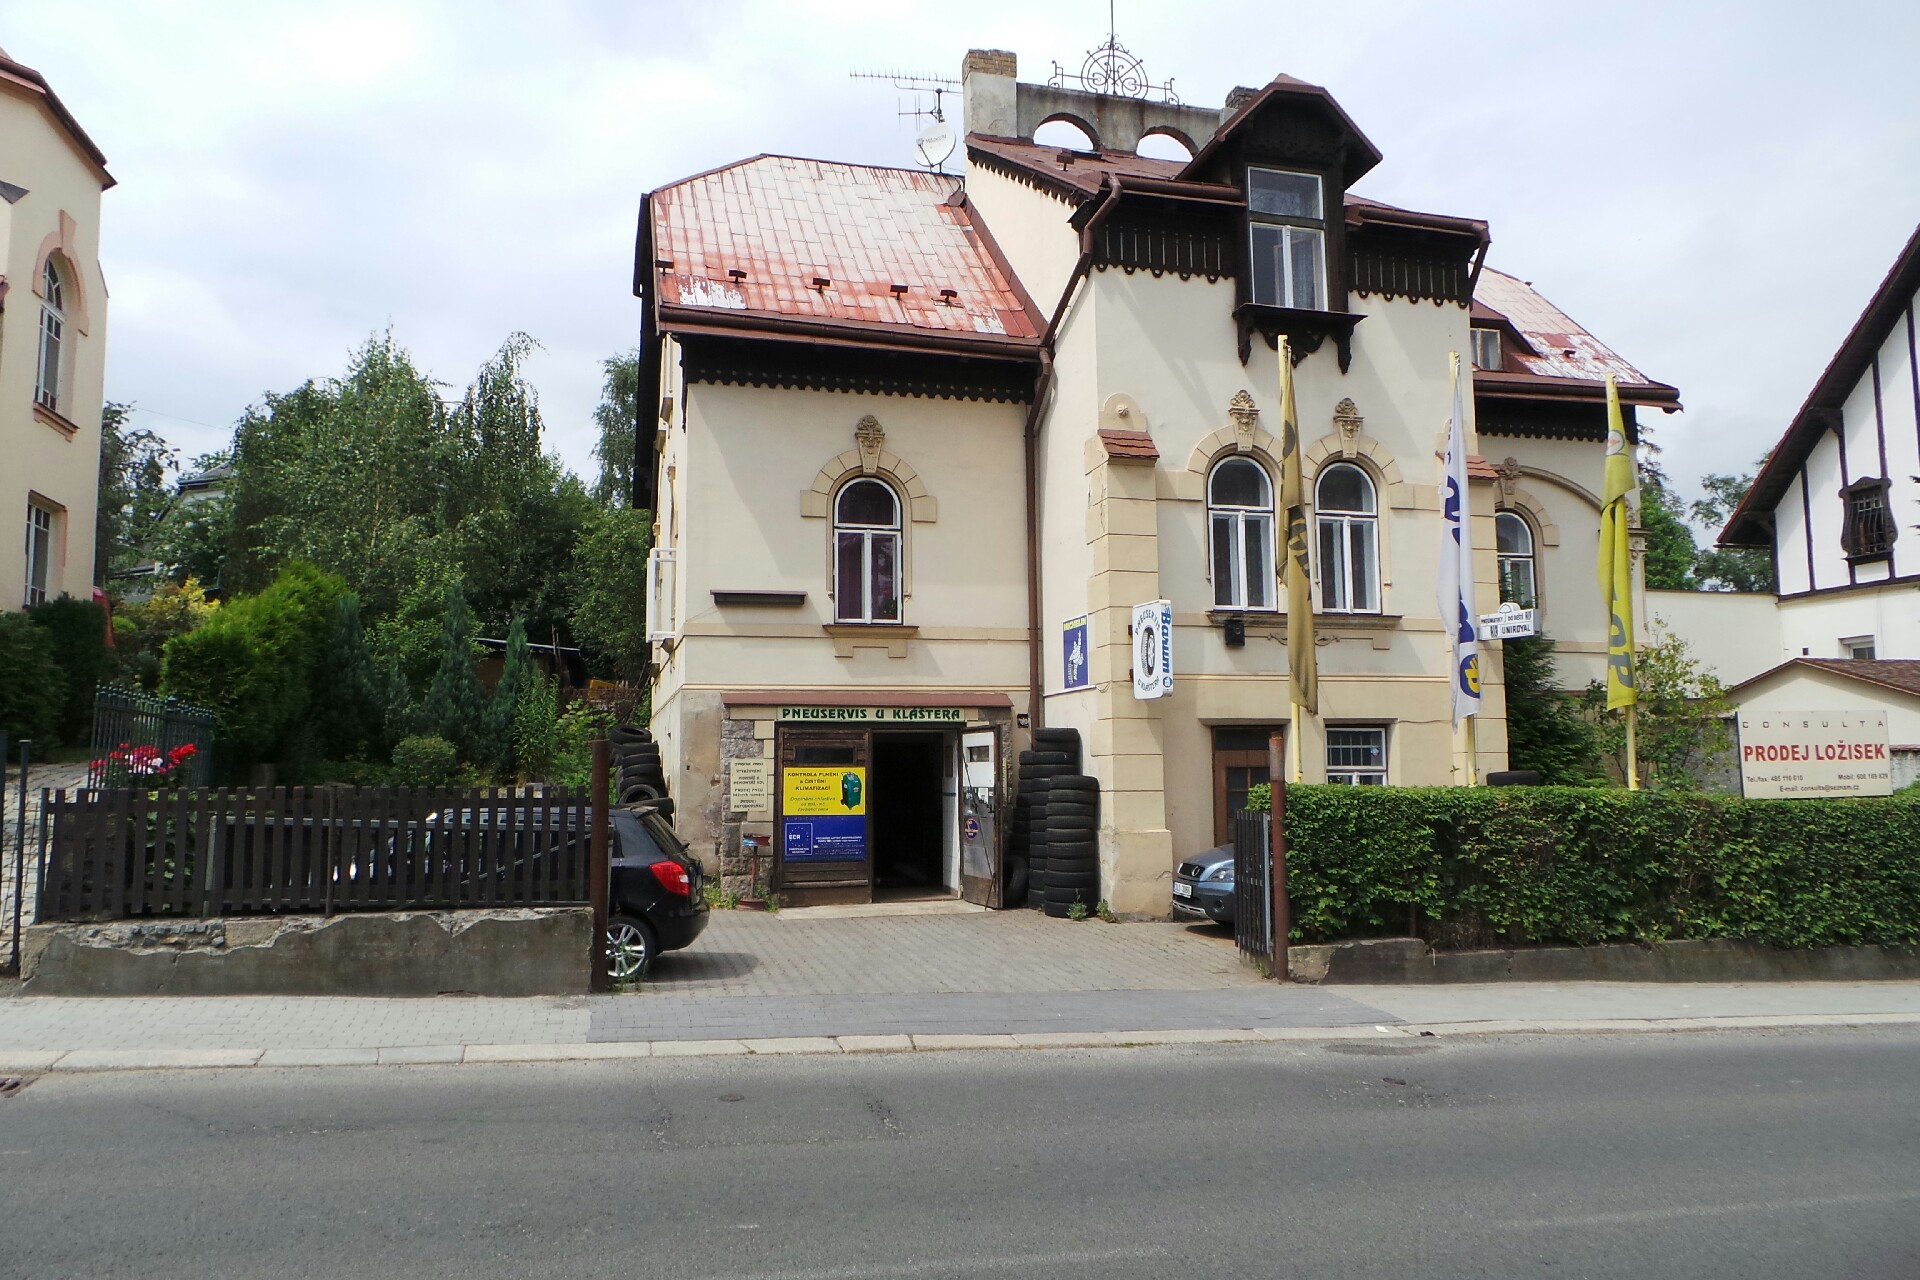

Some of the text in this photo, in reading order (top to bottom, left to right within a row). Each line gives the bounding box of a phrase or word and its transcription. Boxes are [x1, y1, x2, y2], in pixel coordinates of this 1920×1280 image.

[1135, 609, 1160, 635] PNEUSERVIS
[1502, 624, 1531, 634] UNIROYAL
[1161, 609, 1171, 674] Barum
[782, 707, 960, 720] PNEUSERVIS U KLÁŠTERA
[1742, 720, 1884, 728] CONSULTA
[1743, 740, 1886, 762] PRODEJ LOŽISEK
